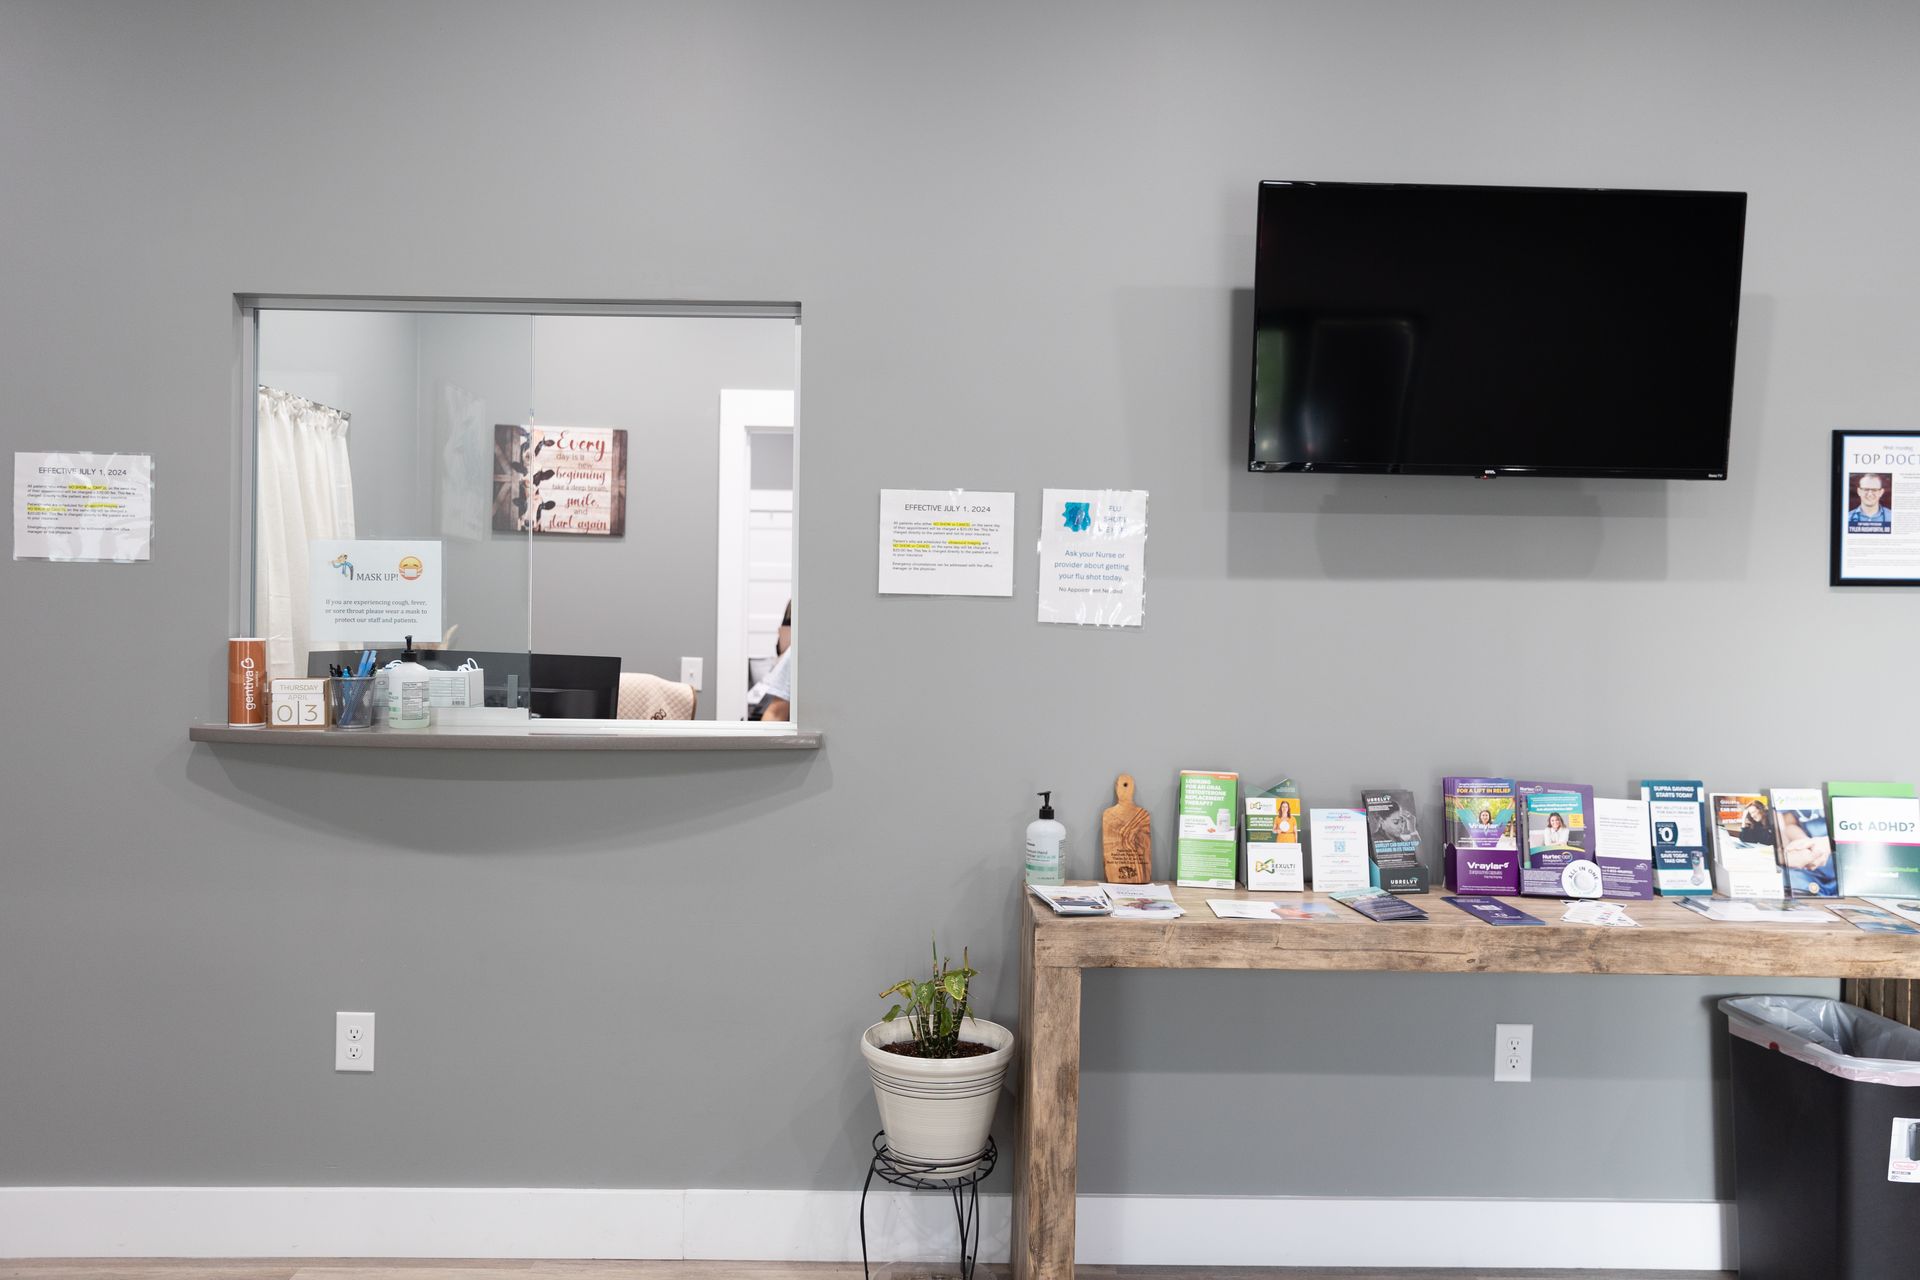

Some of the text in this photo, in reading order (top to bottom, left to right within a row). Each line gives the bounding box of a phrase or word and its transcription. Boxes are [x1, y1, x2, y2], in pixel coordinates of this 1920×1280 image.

[557, 430, 605, 462] Every
[1854, 453, 1881, 465] TOP
[556, 466, 605, 484] beginning
[904, 504, 942, 512] EFFECTIVE
[549, 514, 607, 534] start again
[1054, 561, 1082, 569] provider
[1105, 563, 1129, 571] getting
[356, 573, 399, 581] MASK UP!
[1102, 574, 1123, 582] today.
[244, 670, 256, 711] gentiva
[1839, 820, 1915, 832] Got ADHD?
[1467, 861, 1504, 871] Vraylar
[1568, 869, 1578, 879] ALL
[1588, 869, 1599, 879] ONE
